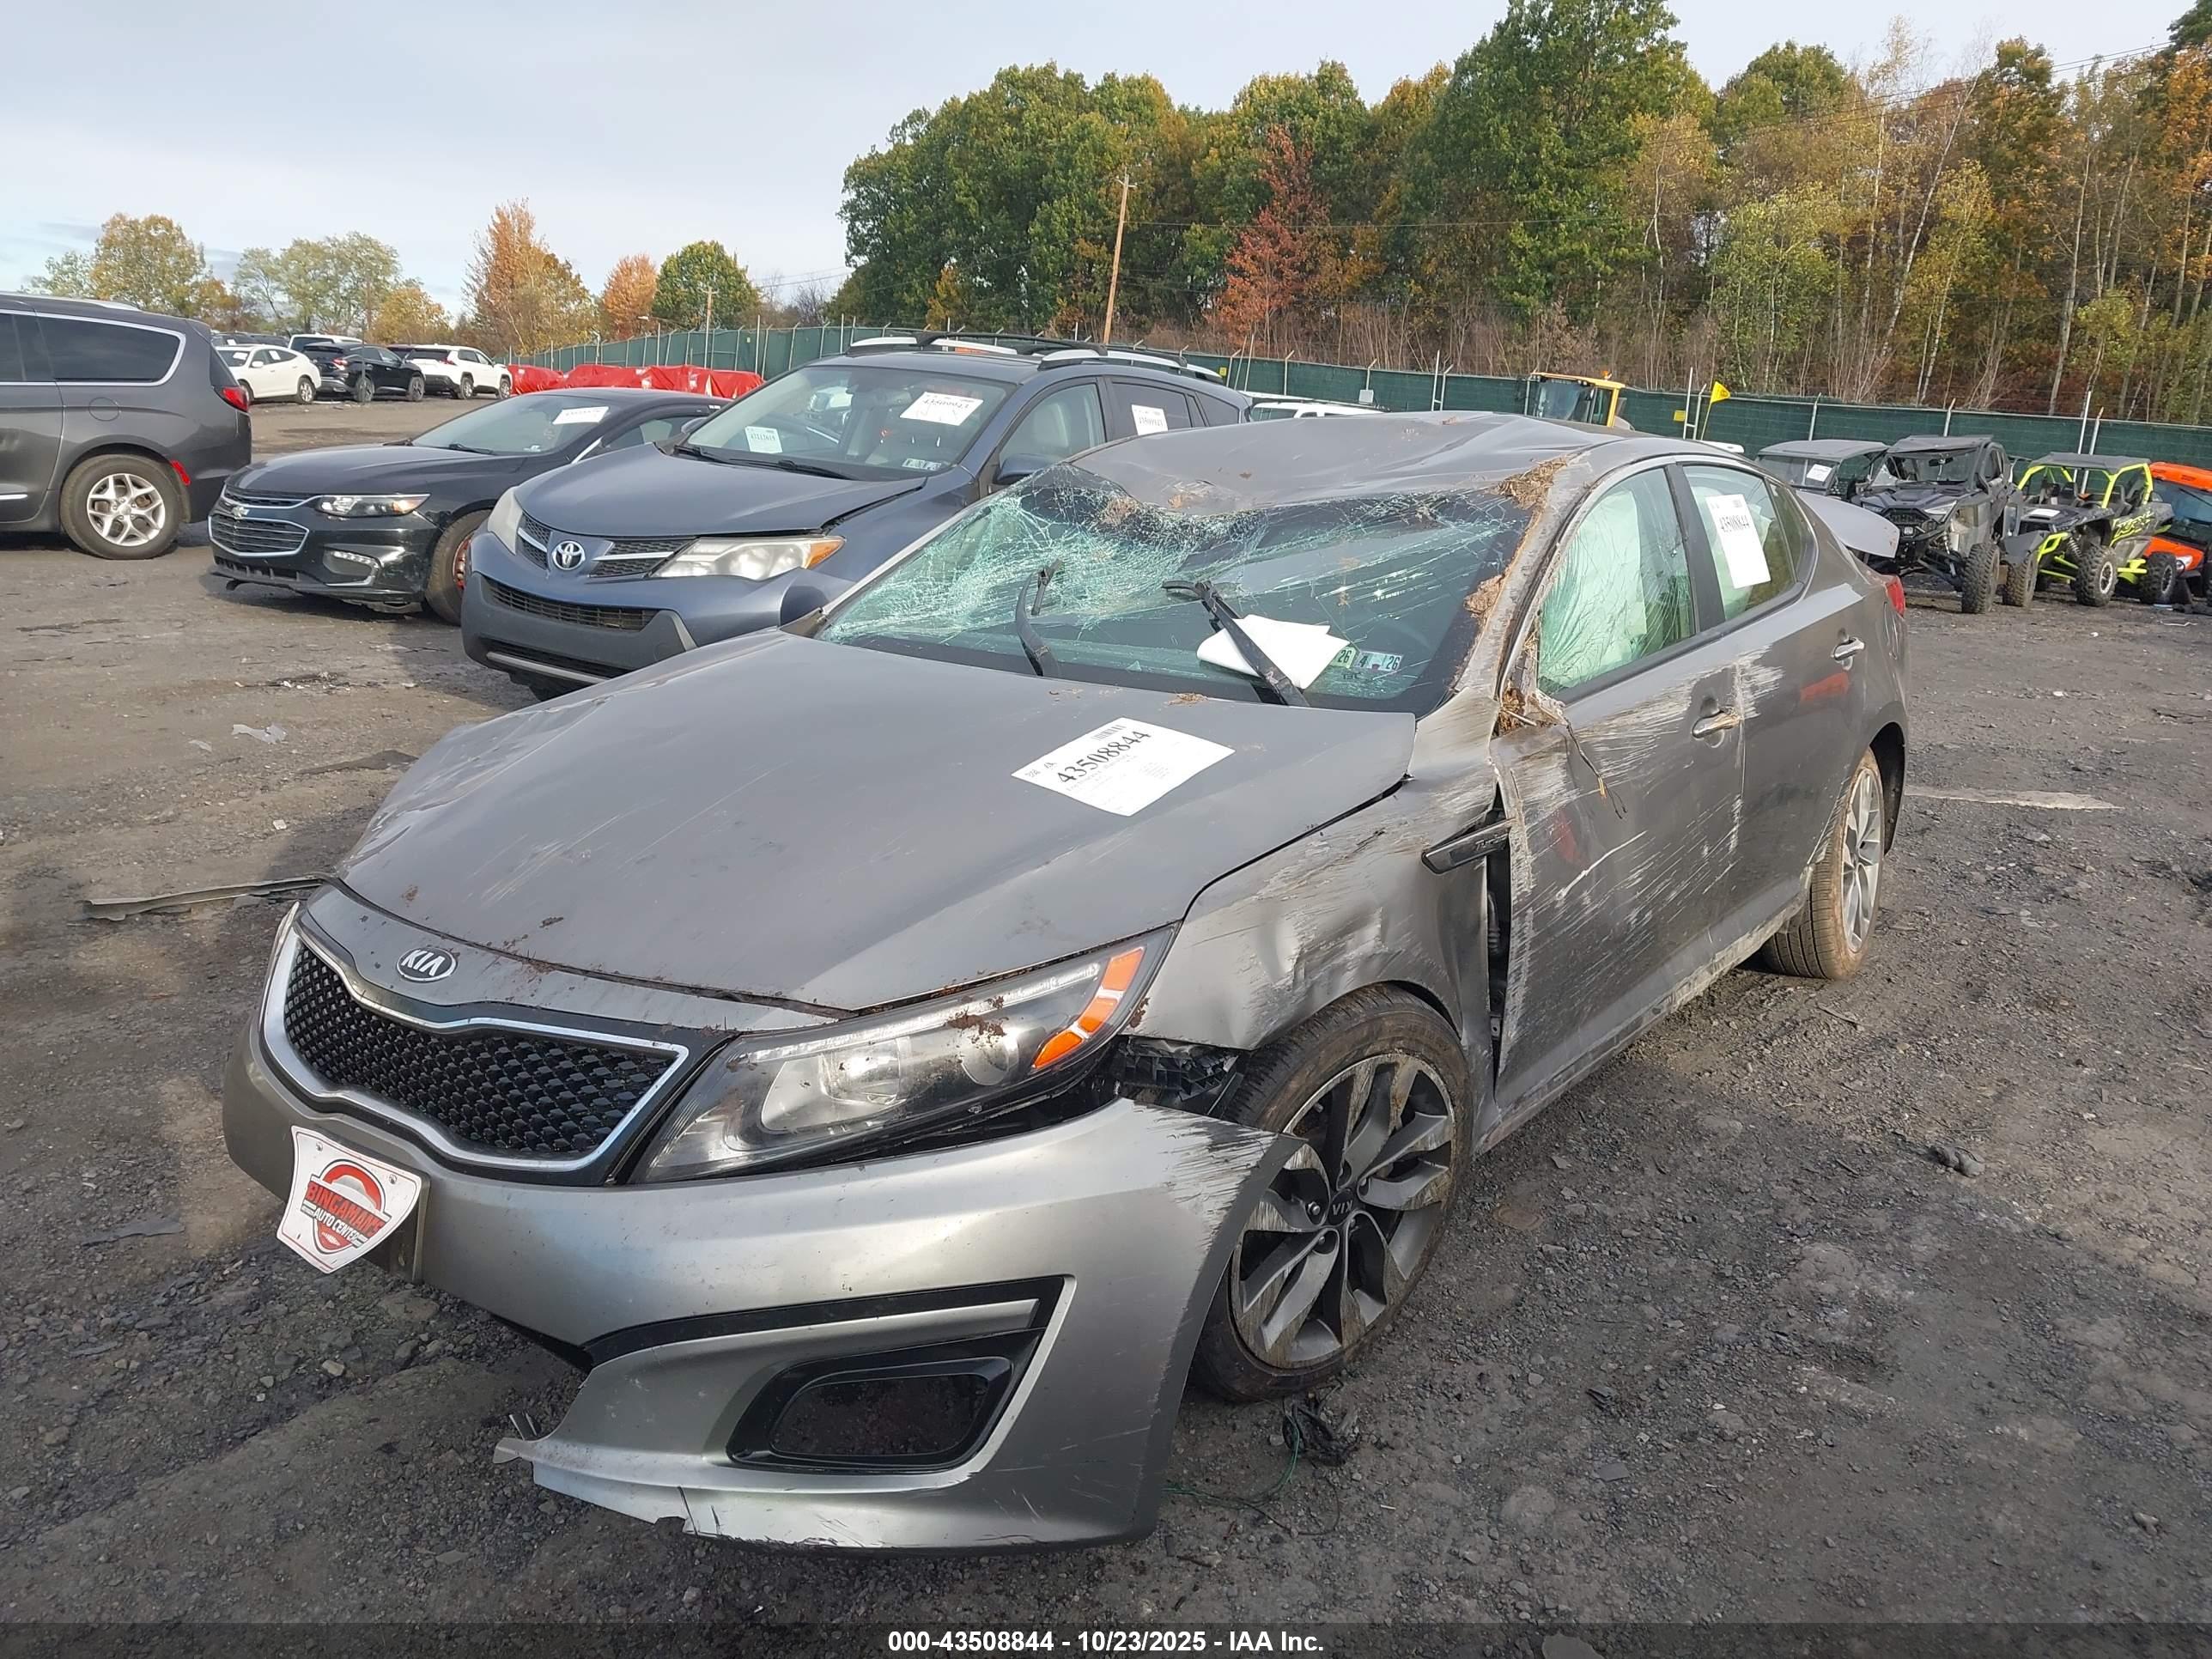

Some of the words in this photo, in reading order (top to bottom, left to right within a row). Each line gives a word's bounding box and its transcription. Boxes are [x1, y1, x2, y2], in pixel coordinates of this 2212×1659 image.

[1337, 650, 1352, 664] 26
[1386, 655, 1401, 670] 26
[1057, 731, 1151, 783] 43508844
[400, 949, 446, 976] KIA
[313, 1206, 335, 1228] AUTO
[331, 1218, 361, 1242] CENTER
